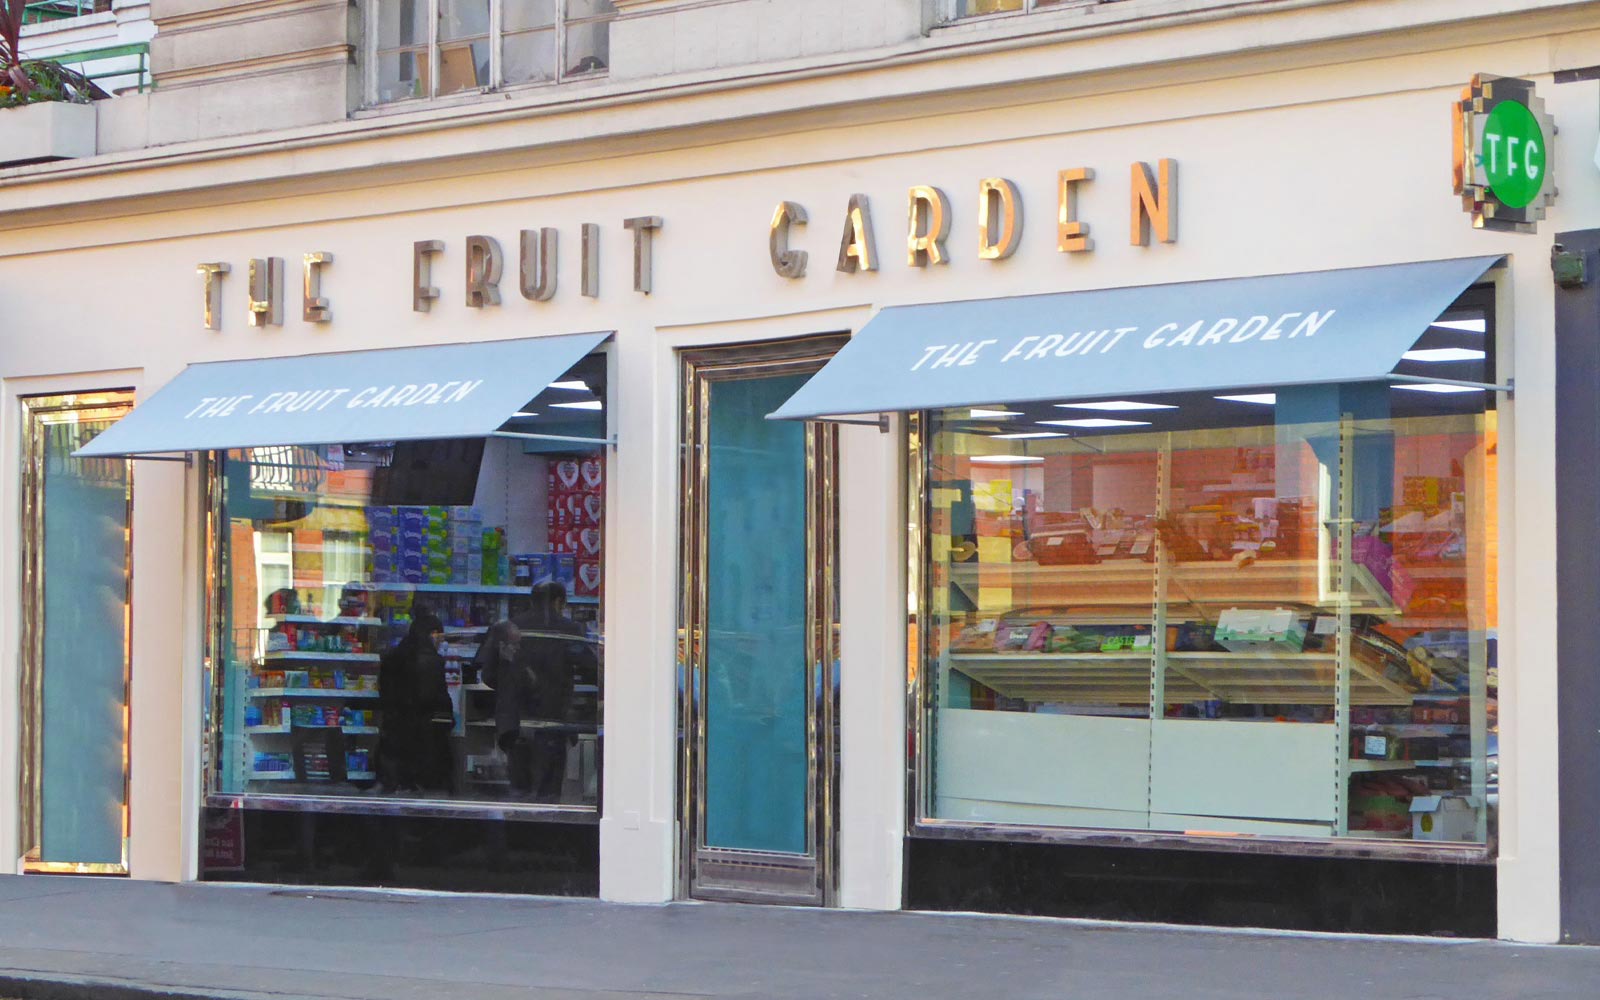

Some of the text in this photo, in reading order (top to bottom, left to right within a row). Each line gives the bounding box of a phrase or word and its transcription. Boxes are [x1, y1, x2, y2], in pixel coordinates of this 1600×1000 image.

[1486, 132, 1539, 180] TFG
[196, 157, 1178, 331] THE FRUIT GARDEN
[910, 310, 1336, 372] THE FRUIT GARDEN
[184, 379, 483, 419] THE FRUIT GARDEN
